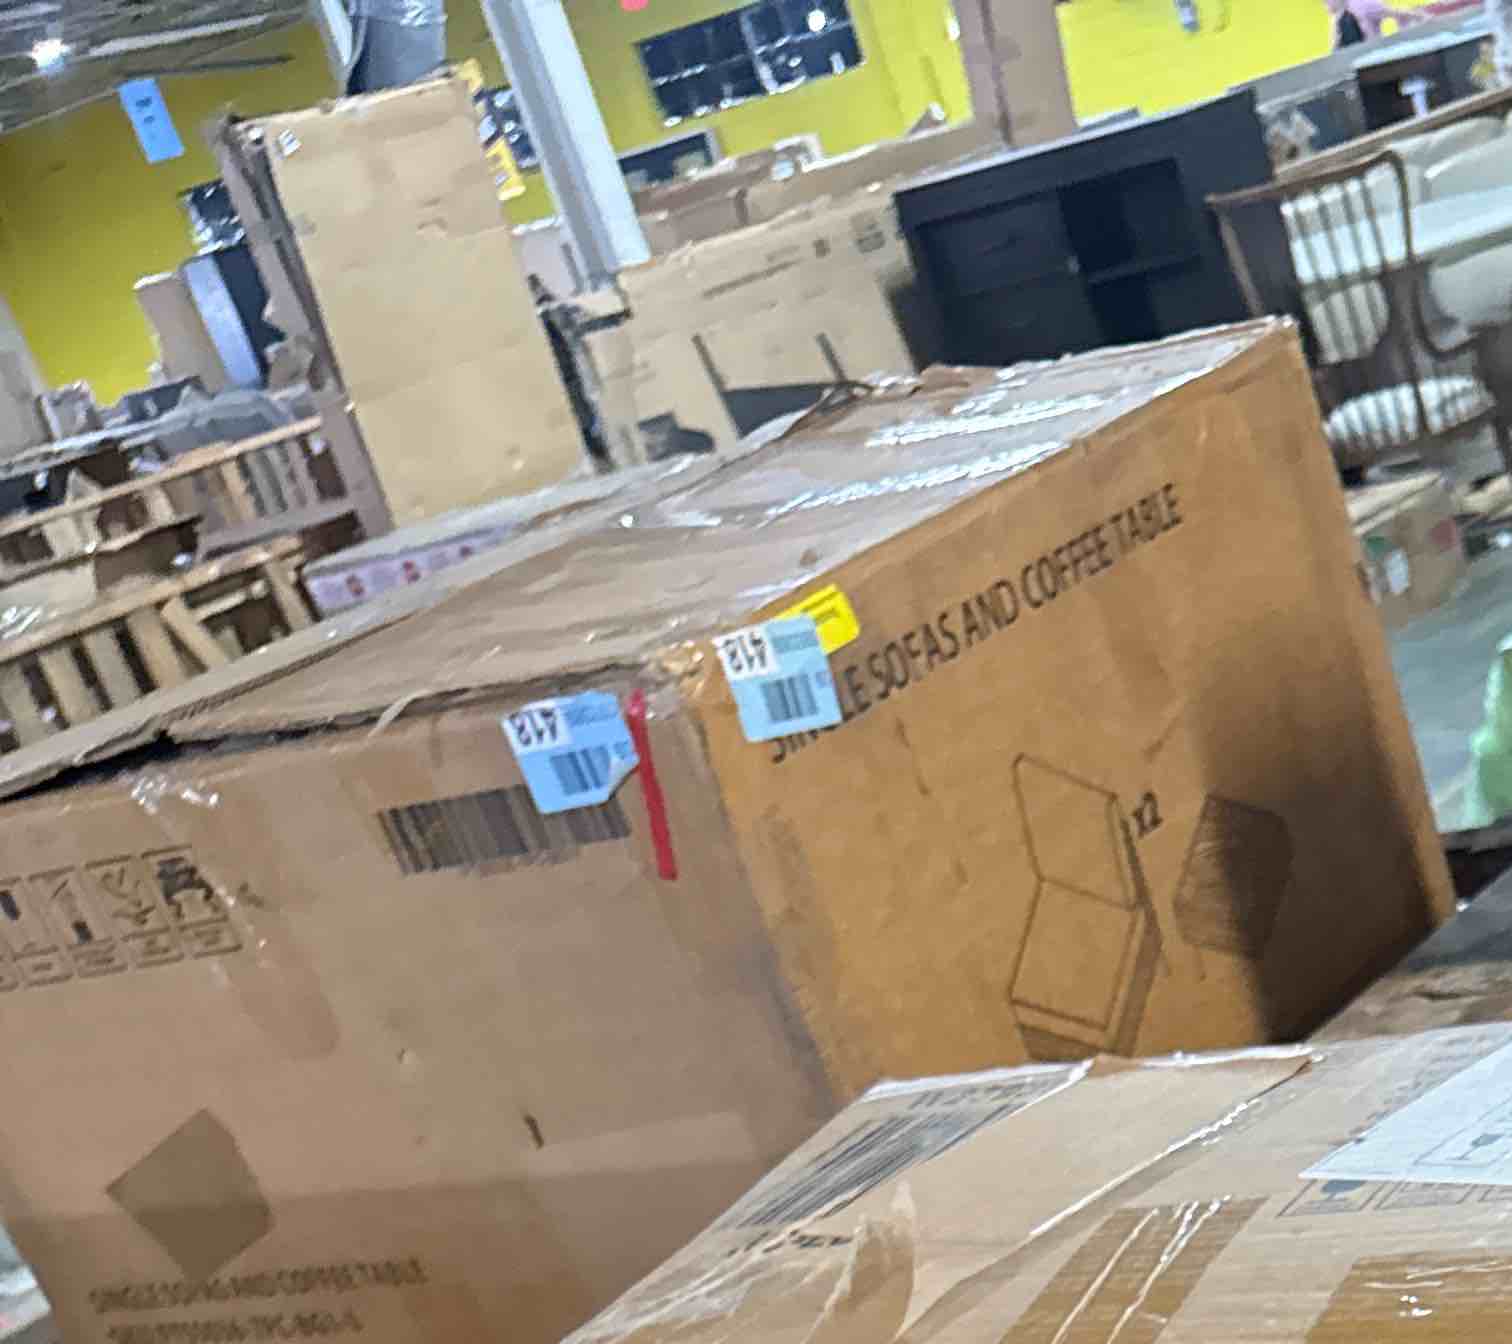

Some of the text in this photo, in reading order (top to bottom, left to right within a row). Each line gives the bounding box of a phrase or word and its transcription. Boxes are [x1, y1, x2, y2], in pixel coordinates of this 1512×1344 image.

[870, 482, 1184, 703] SOFAS AND COFFEE TABLE
